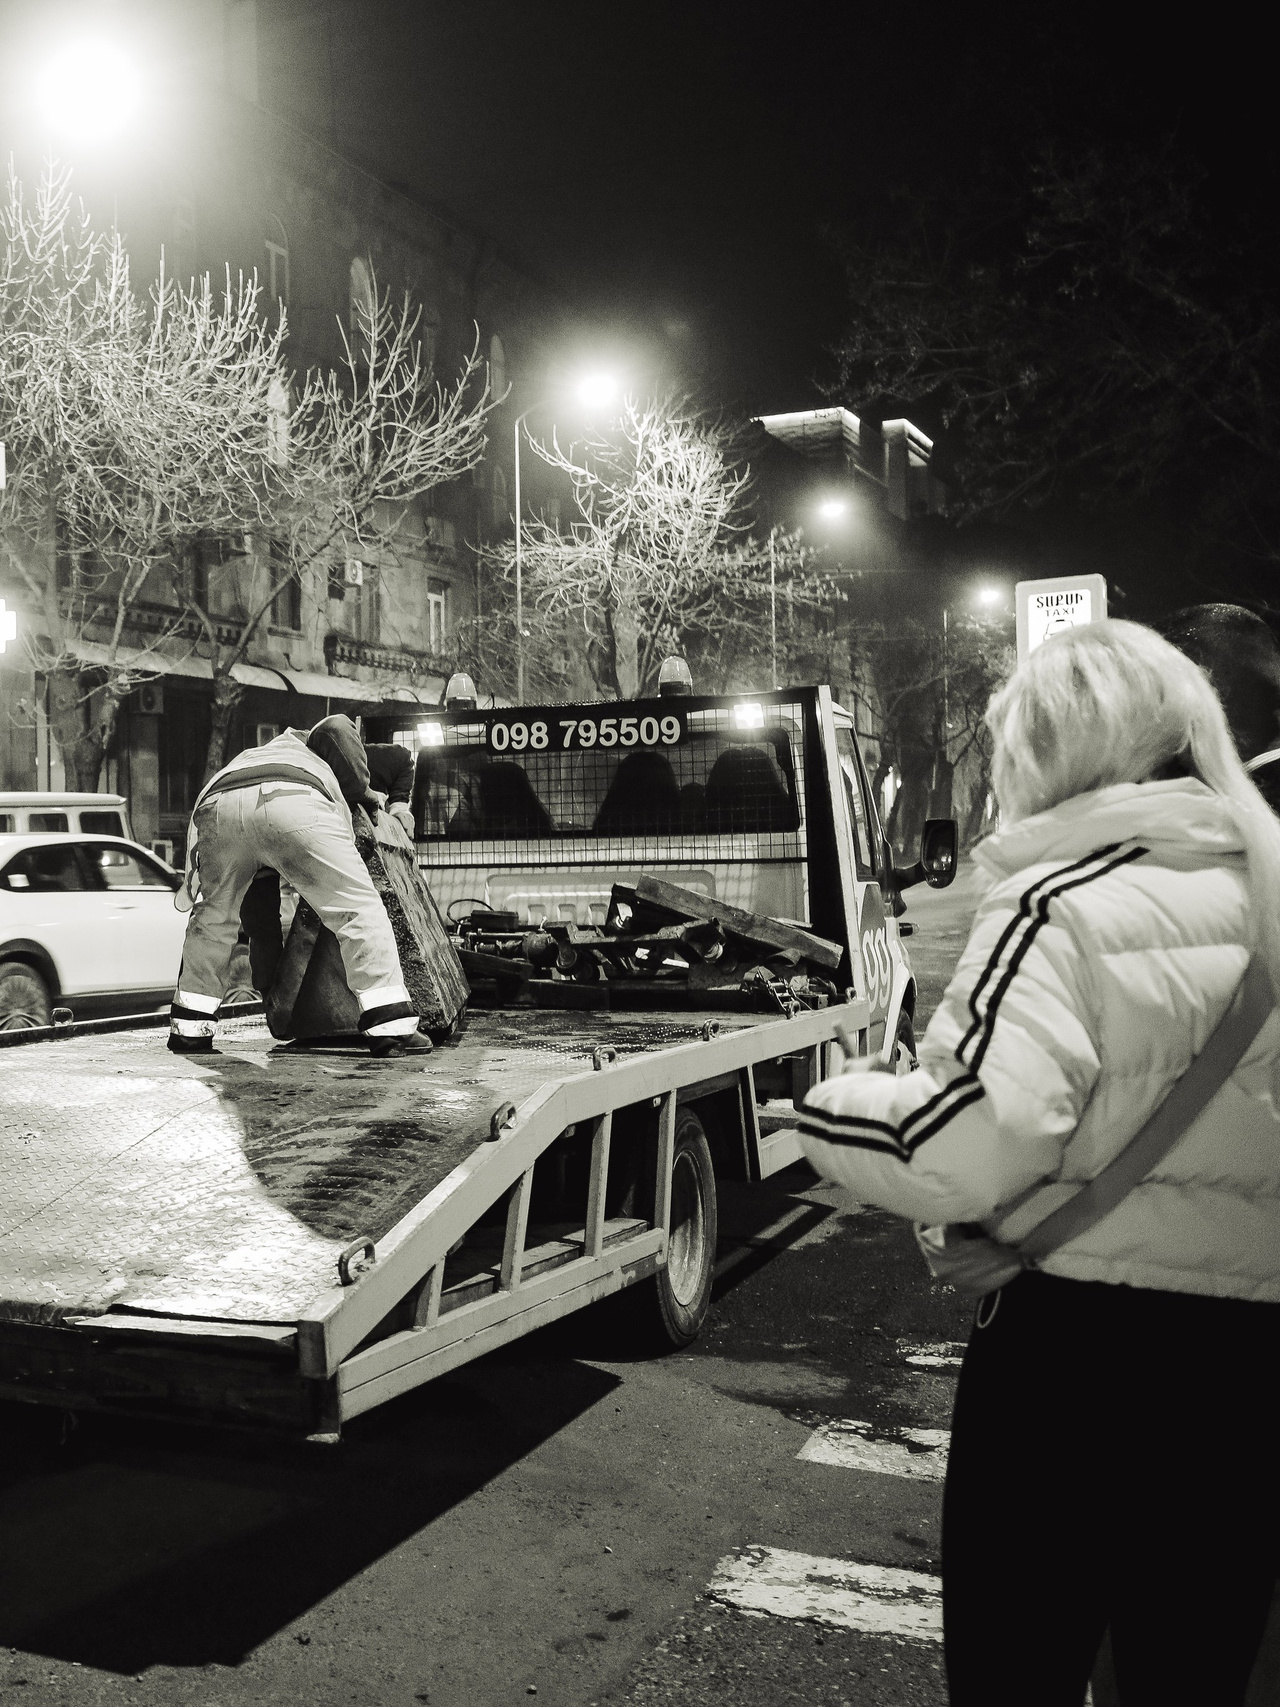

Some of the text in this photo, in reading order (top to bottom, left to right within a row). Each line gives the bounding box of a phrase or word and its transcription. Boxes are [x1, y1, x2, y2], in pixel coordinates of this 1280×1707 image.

[1045, 607, 1075, 617] TAXI
[491, 716, 681, 751] 098 795509
